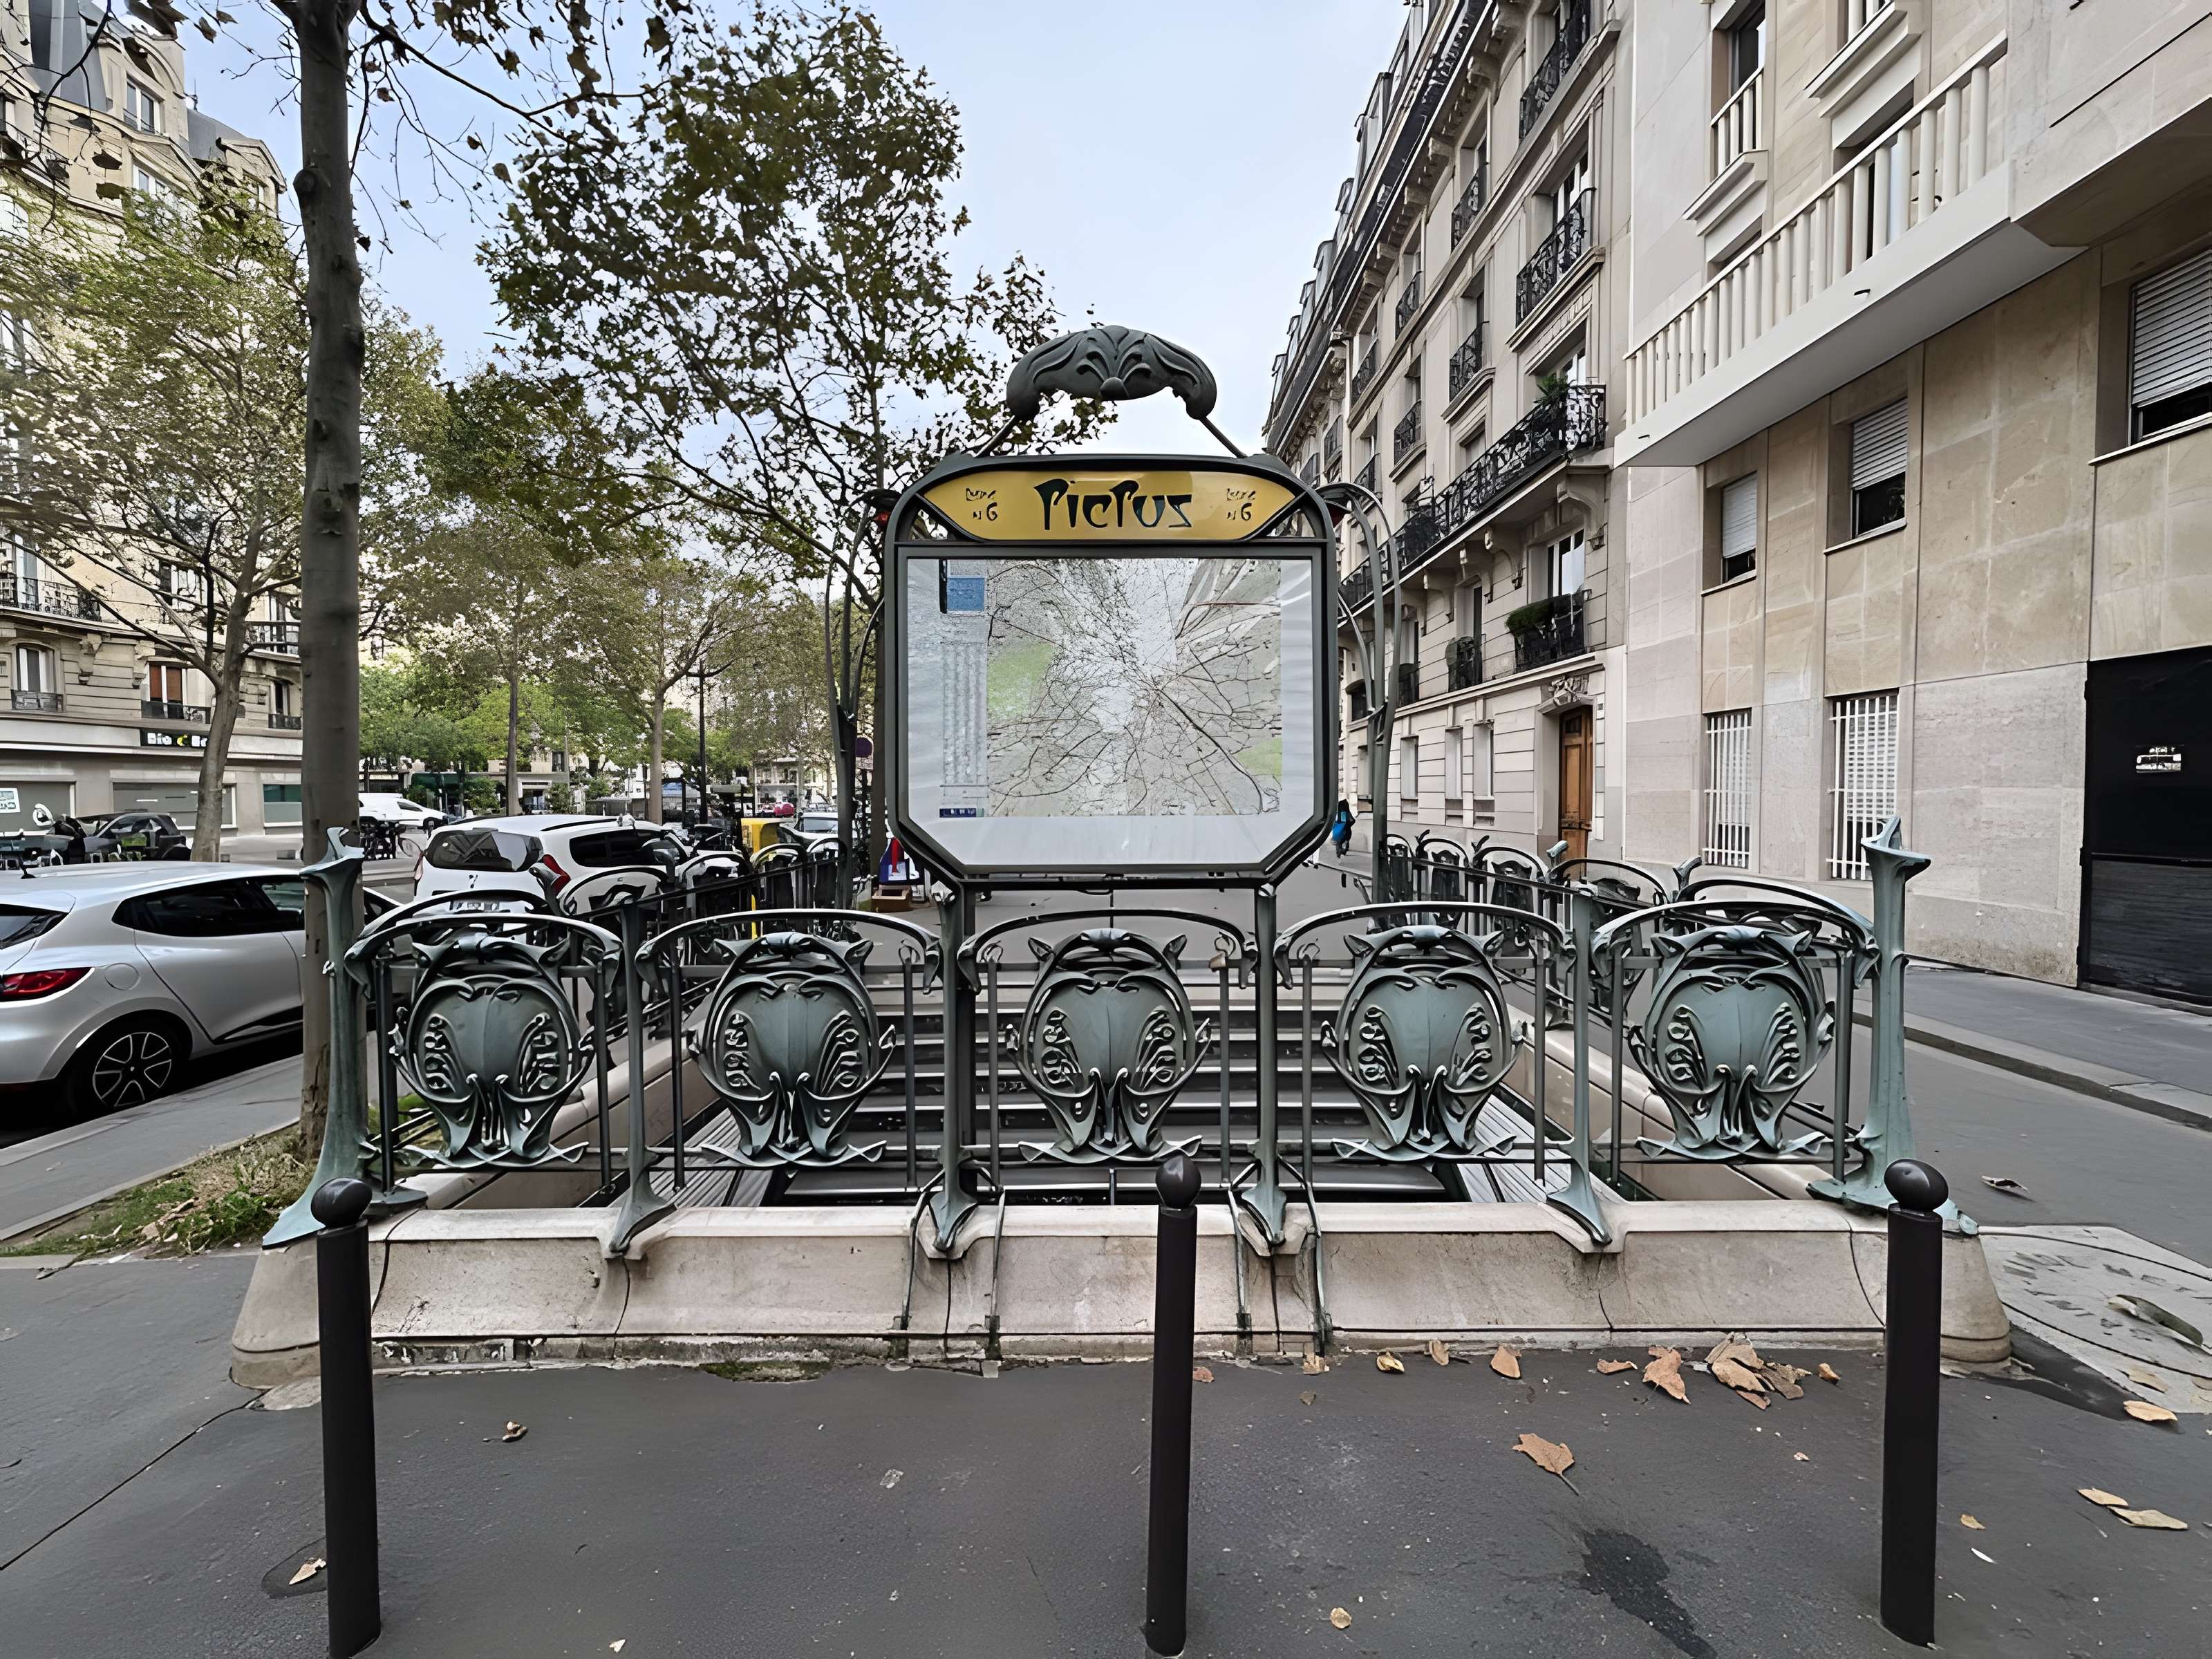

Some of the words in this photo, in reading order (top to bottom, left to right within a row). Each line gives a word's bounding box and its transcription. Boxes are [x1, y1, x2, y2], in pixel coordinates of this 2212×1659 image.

[986, 502, 997, 521] 6
[1033, 478, 1192, 530] Picpus
[1241, 503, 1252, 521] 6
